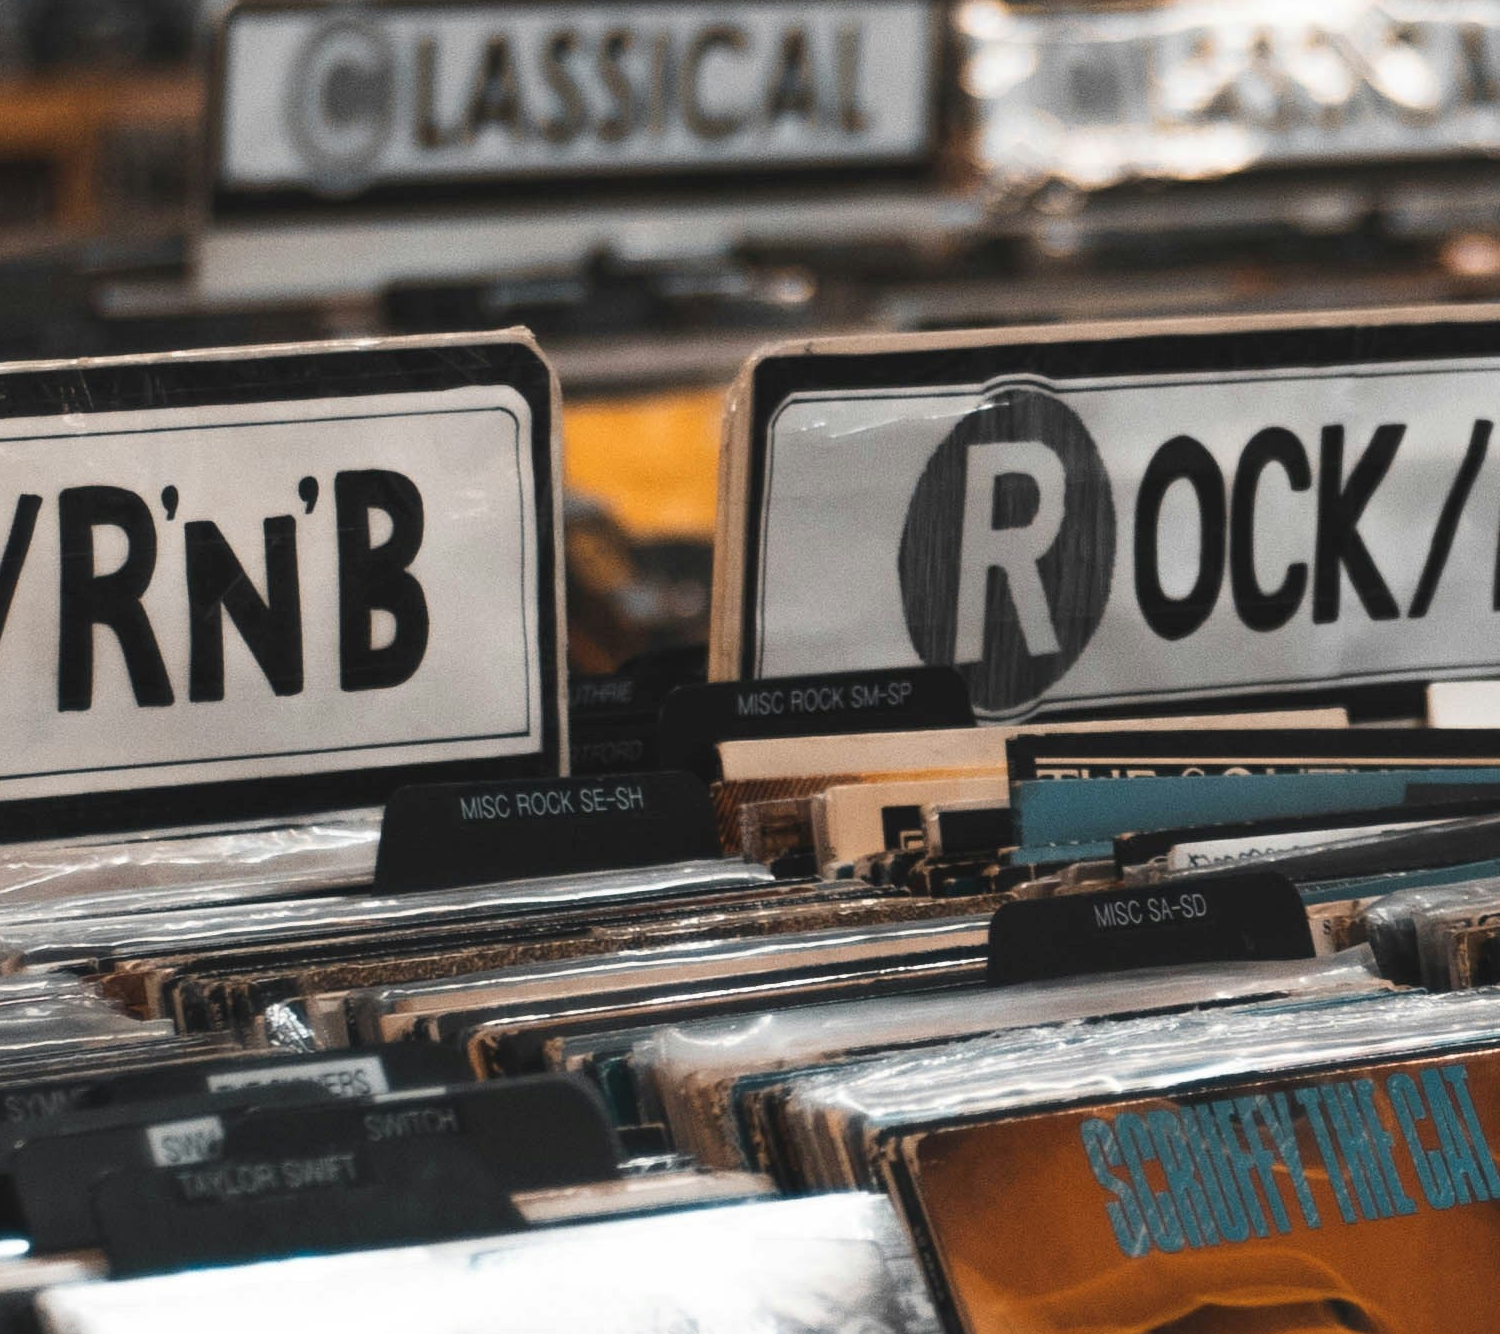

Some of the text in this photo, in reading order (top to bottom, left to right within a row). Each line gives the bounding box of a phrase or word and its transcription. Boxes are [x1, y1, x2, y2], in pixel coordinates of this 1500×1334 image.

[308, 21, 868, 167] CLASSICAL
[737, 683, 912, 716] MISC ROCK SM-SP
[460, 785, 645, 821] MISC ROCK SE-SH
[1095, 894, 1207, 929] MISC SA-SD
[363, 1108, 460, 1142] SWITCH
[176, 1151, 357, 1200] TAYLOR SWIFT
[1081, 1090, 1323, 1258] SCRUFFY
[1297, 1075, 1417, 1226] THE
